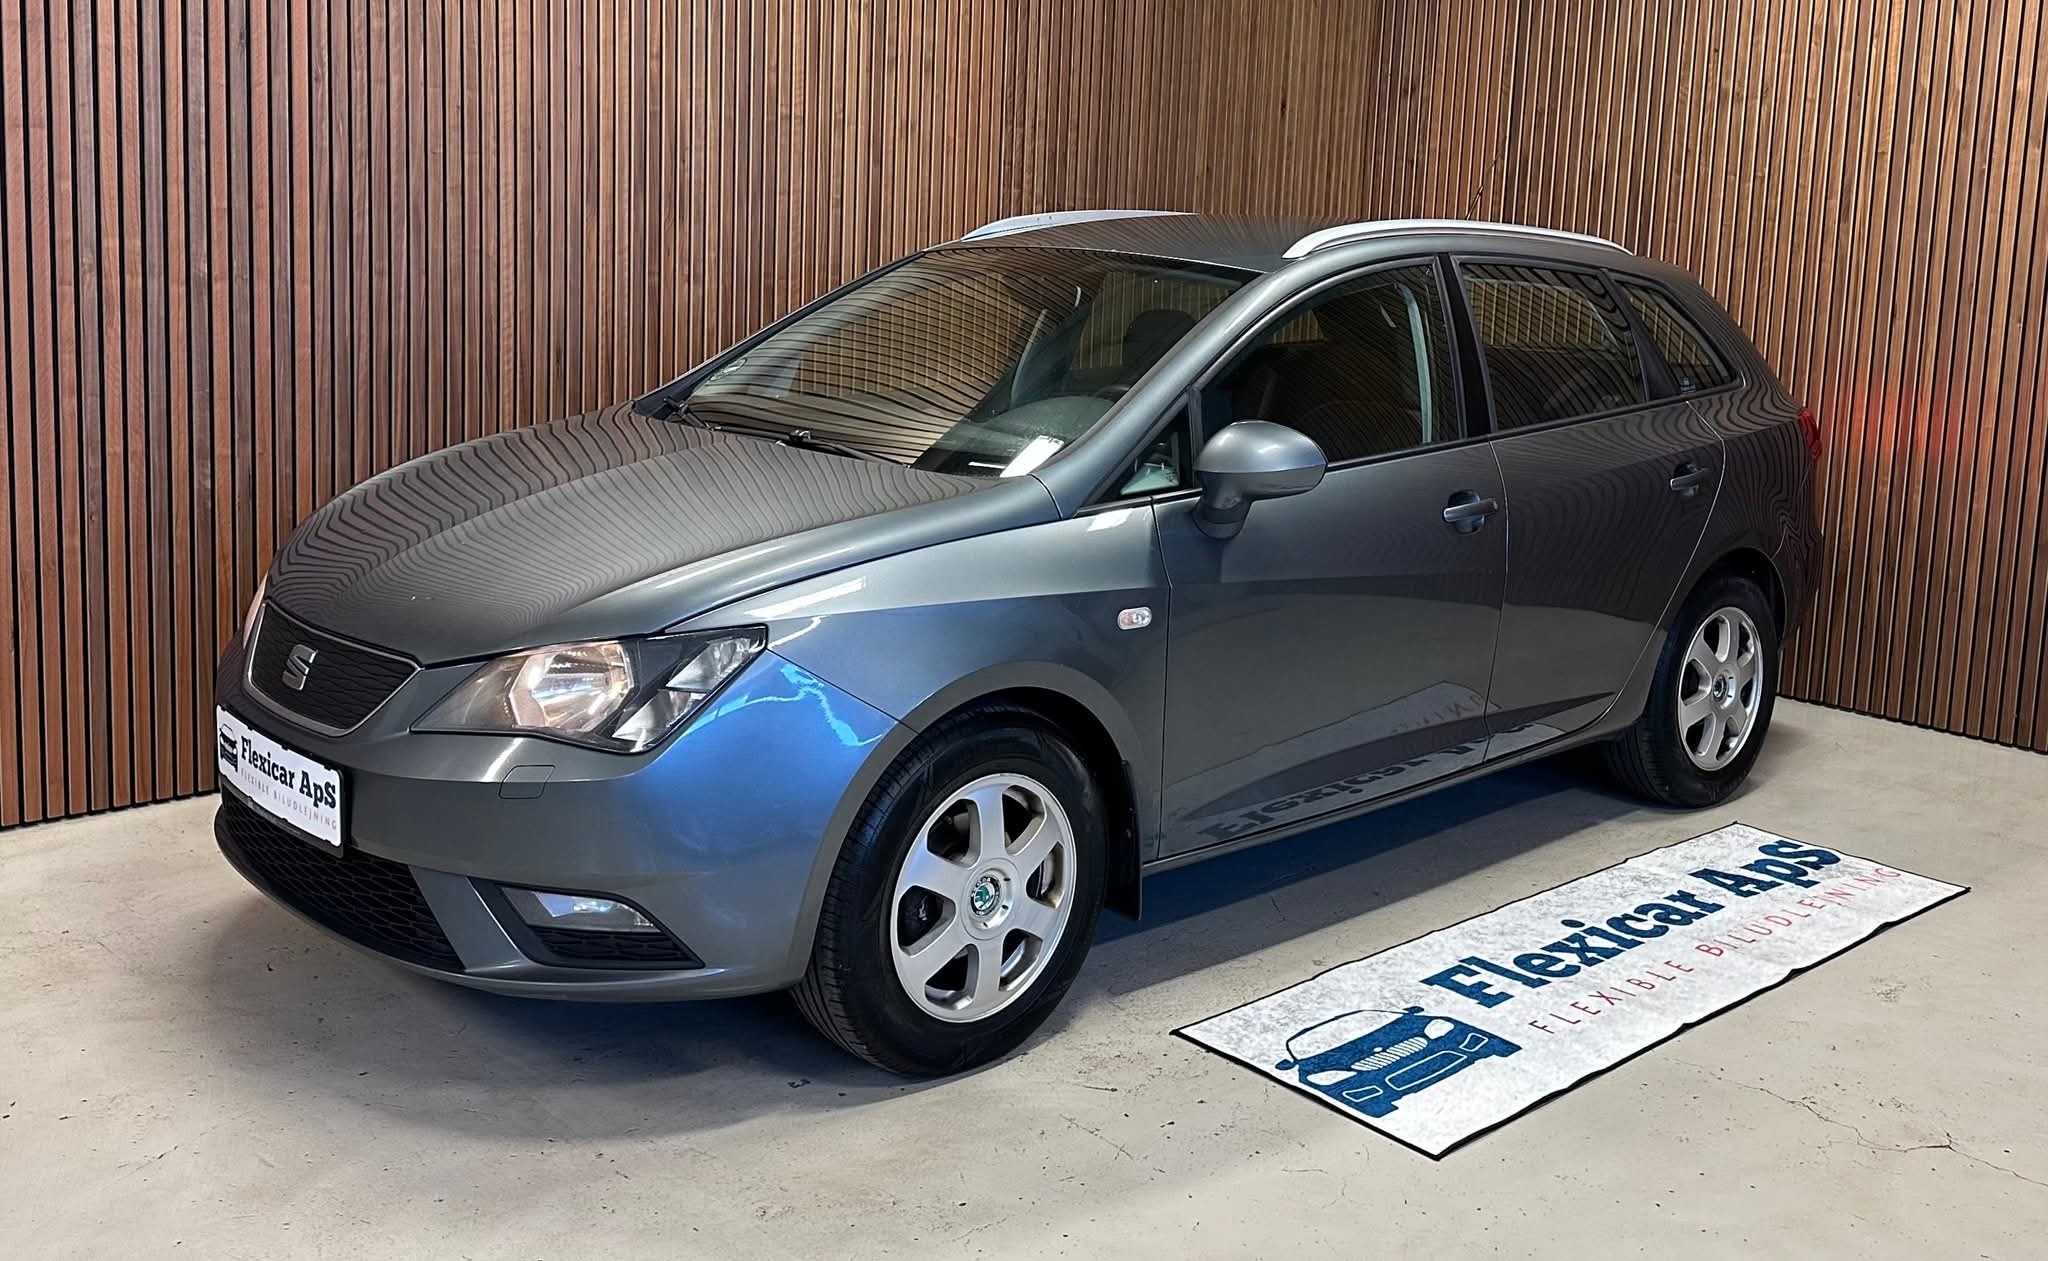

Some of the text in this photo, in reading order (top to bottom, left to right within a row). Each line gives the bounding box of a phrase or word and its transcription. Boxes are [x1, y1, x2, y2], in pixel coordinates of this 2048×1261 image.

[241, 735, 337, 809] Flexicar ApS
[241, 767, 270, 796] FLEXIBLE
[1420, 840, 1842, 1009] Flexicar ApS
[1528, 867, 1902, 1034] FLEXIBLE BILUDLEJNING
